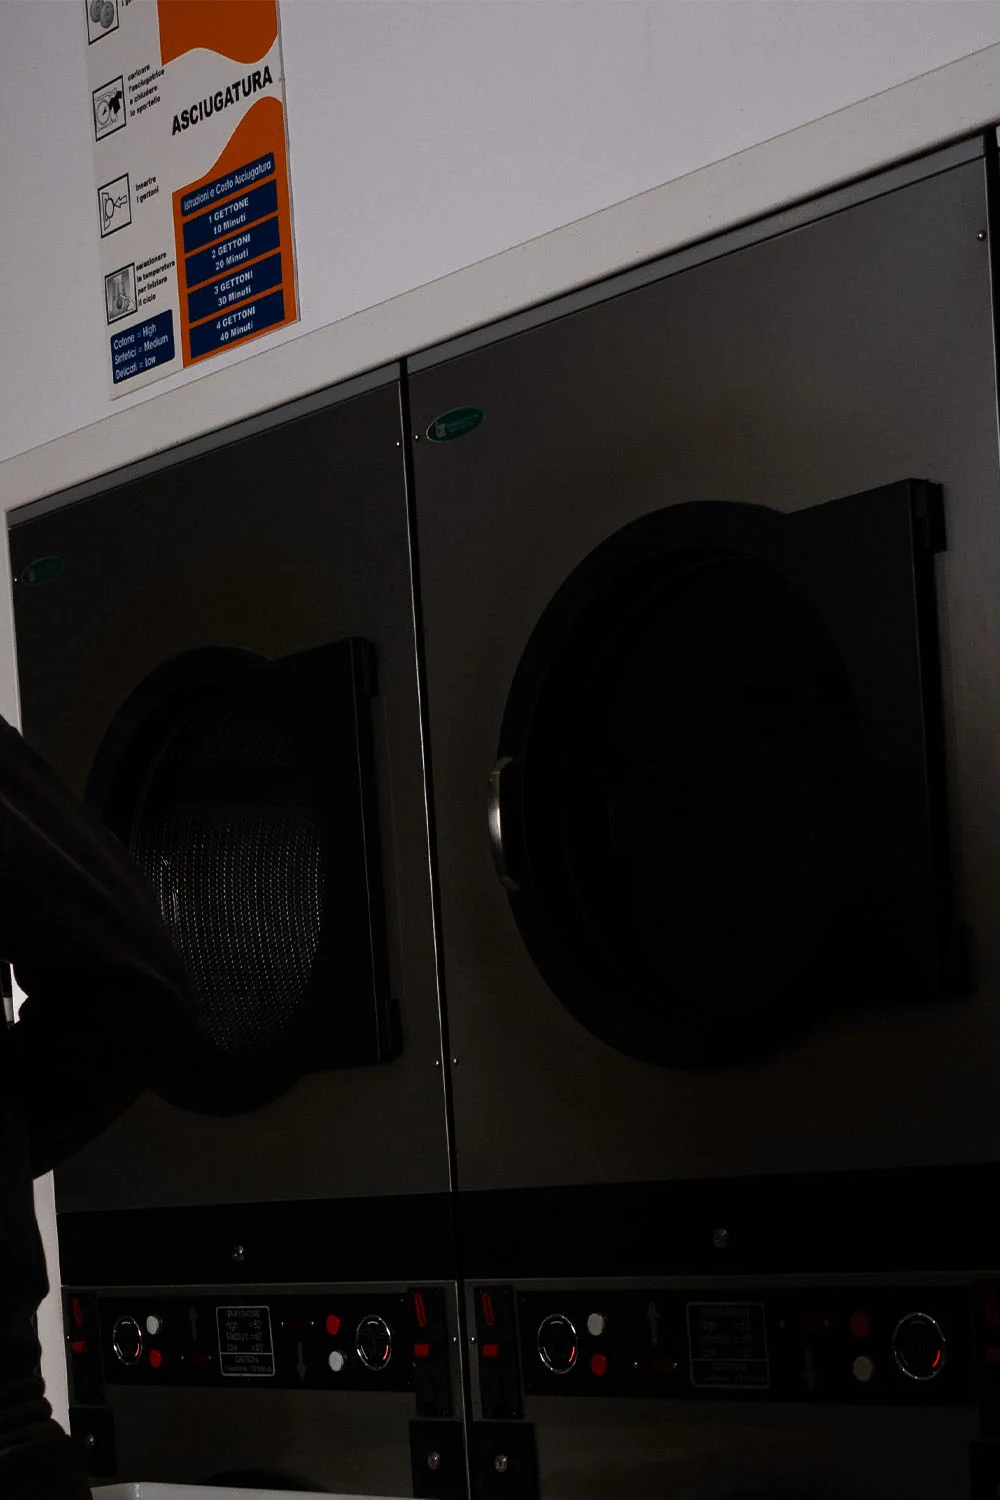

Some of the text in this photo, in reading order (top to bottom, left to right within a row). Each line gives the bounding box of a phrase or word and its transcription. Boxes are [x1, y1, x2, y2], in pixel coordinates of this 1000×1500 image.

[171, 65, 273, 136] ASCIUGATURA
[215, 177, 234, 195] Costo
[235, 160, 271, 188] Asciugatura
[214, 197, 249, 222] GETTONE
[213, 213, 246, 235] 10 Minuti
[211, 233, 251, 259] 2 GETTONI
[215, 248, 249, 271] 20 Minuti
[214, 270, 253, 295] 3 GETTONI
[217, 284, 251, 307] 30 Minuti
[222, 305, 256, 328] GETTONI
[113, 333, 135, 350] Cotone
[142, 323, 157, 340] High
[143, 334, 169, 352] Medium
[219, 320, 254, 343] 40 Minuti
[144, 355, 157, 367] Low
